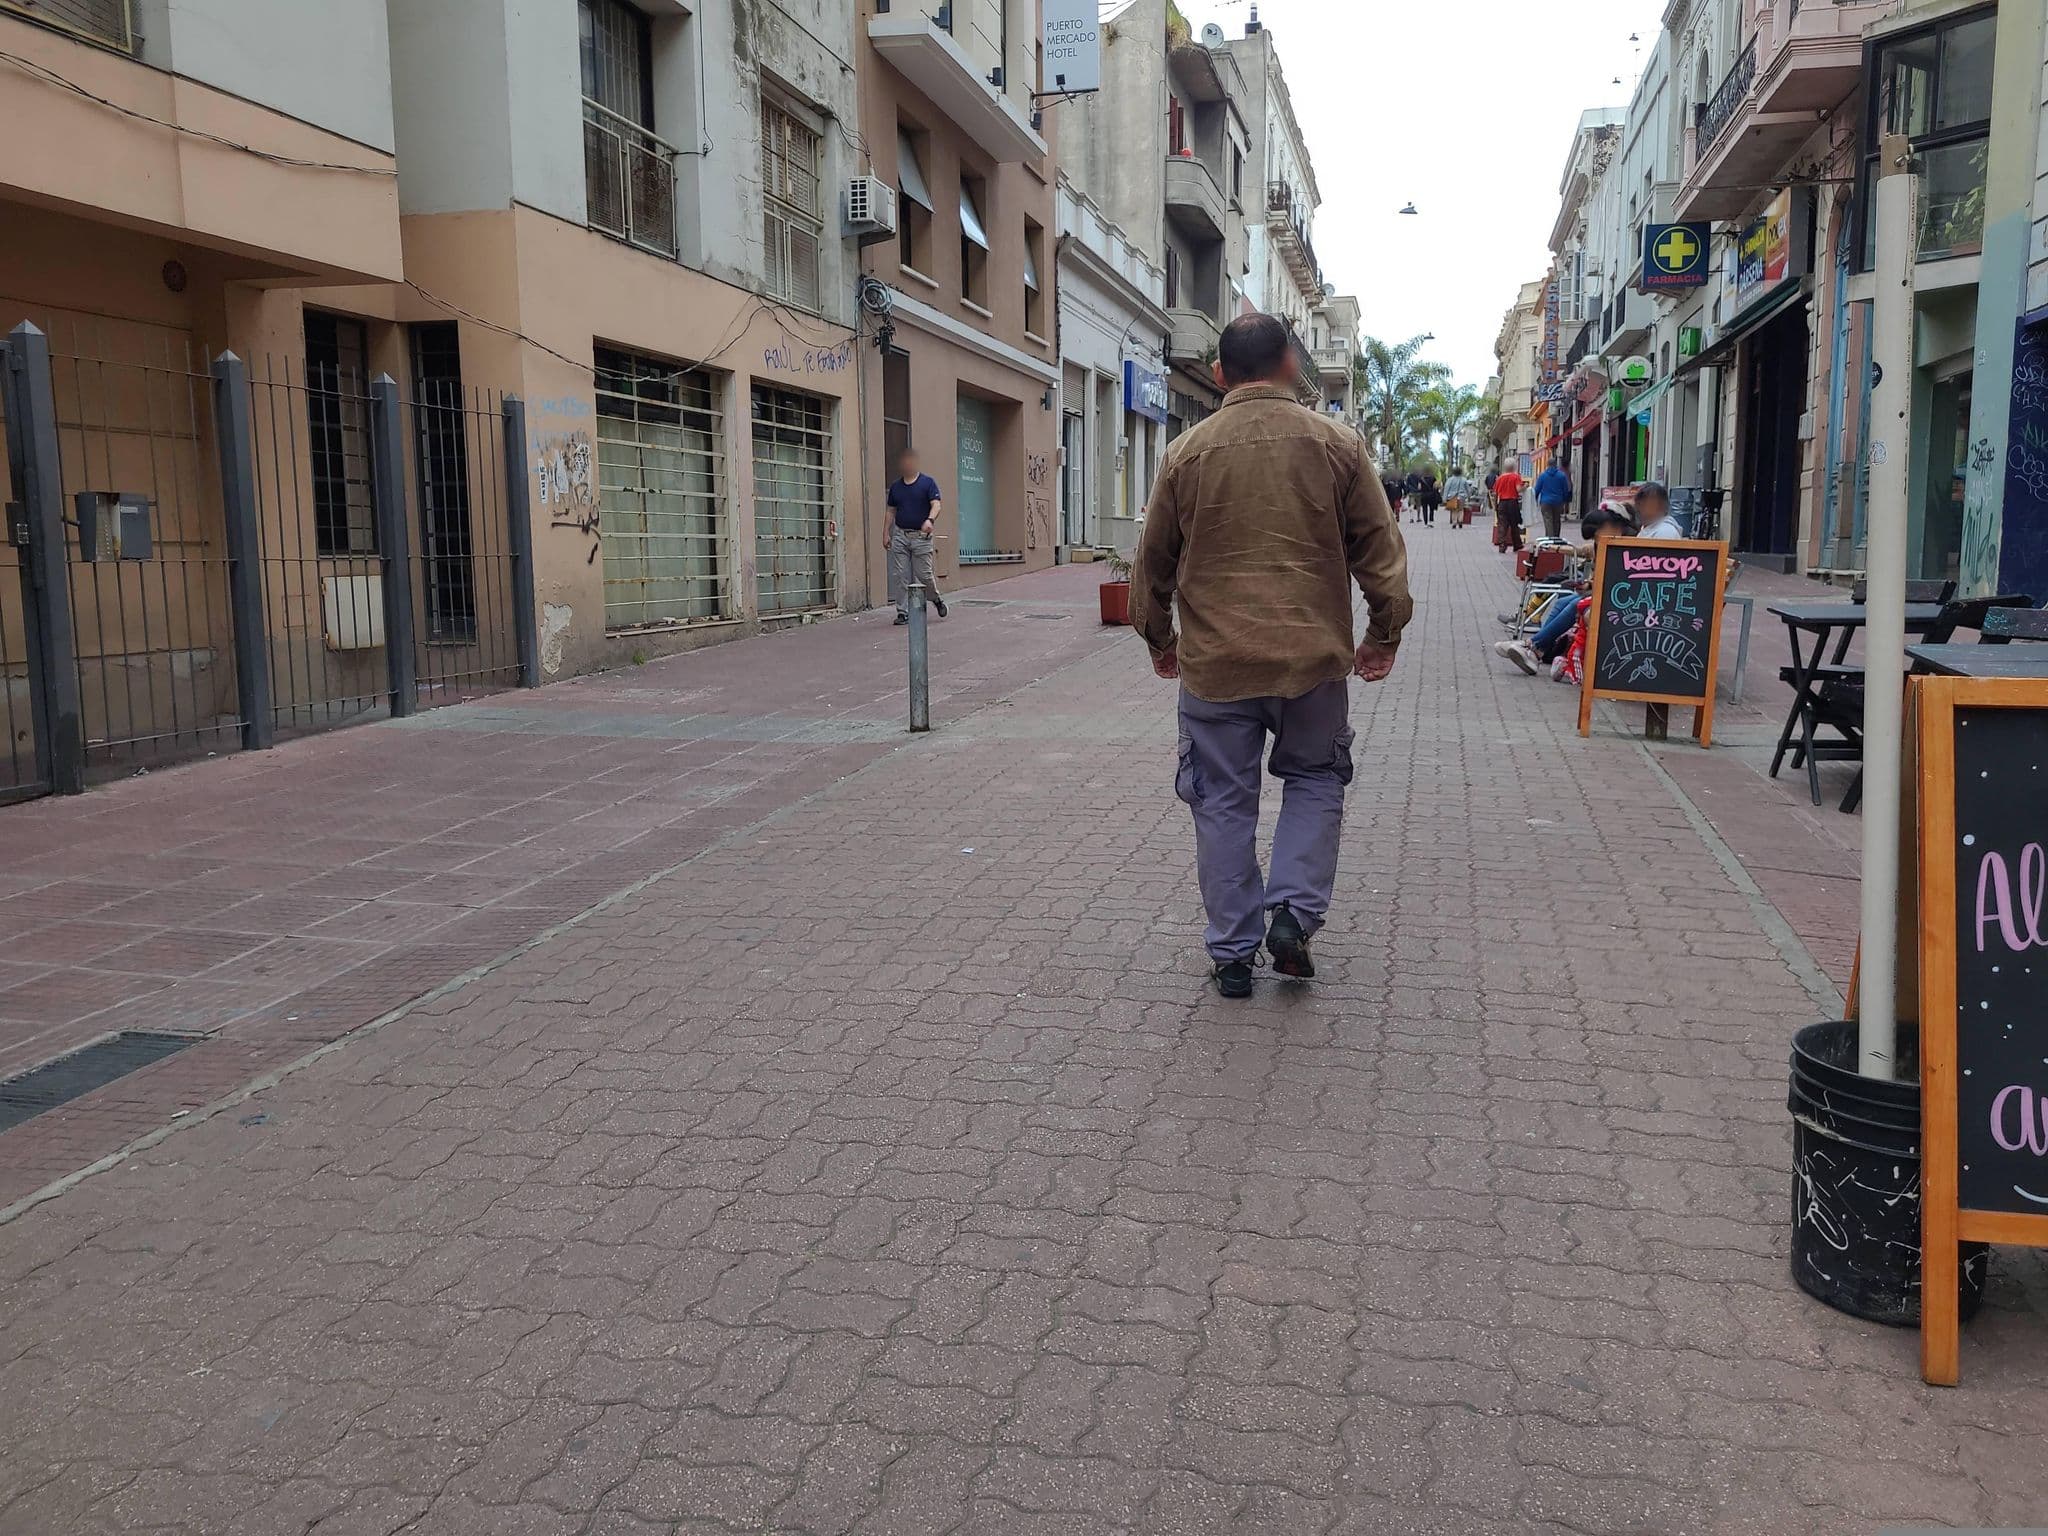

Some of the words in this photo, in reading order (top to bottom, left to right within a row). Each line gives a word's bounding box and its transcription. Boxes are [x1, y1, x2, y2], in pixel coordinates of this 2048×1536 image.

[1046, 19, 1083, 32] PUERTO
[1046, 32, 1096, 45] MERCADO
[1046, 48, 1078, 59] HOTEL
[1647, 274, 1703, 284] FARMACIA
[1610, 575, 1697, 614] CAFÉ
[1644, 609, 1659, 628] &
[1618, 629, 1686, 659] TATTOO
